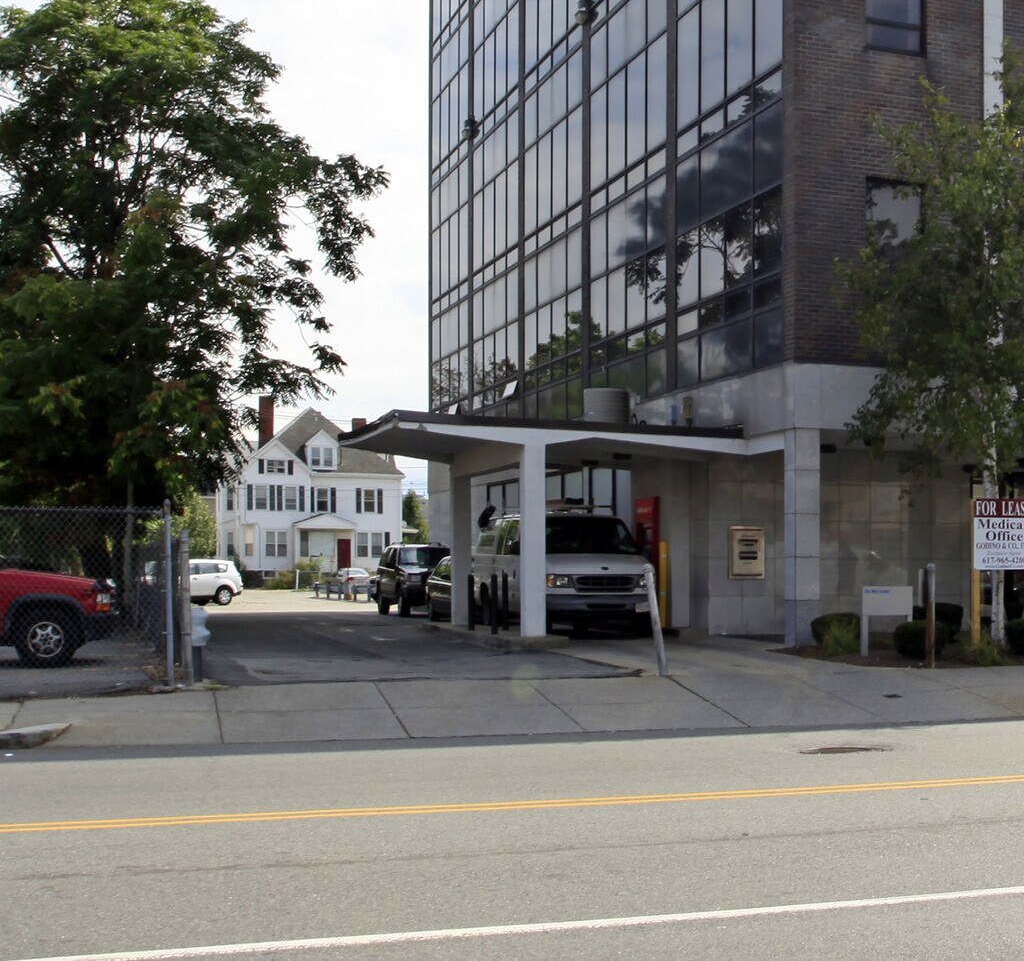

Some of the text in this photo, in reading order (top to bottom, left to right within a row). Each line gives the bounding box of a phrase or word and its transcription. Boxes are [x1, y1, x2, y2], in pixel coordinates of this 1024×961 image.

[975, 500, 997, 516] FOR
[985, 530, 1023, 542] Office
[975, 542, 1000, 550] GODINO
[1001, 542, 1007, 550] &
